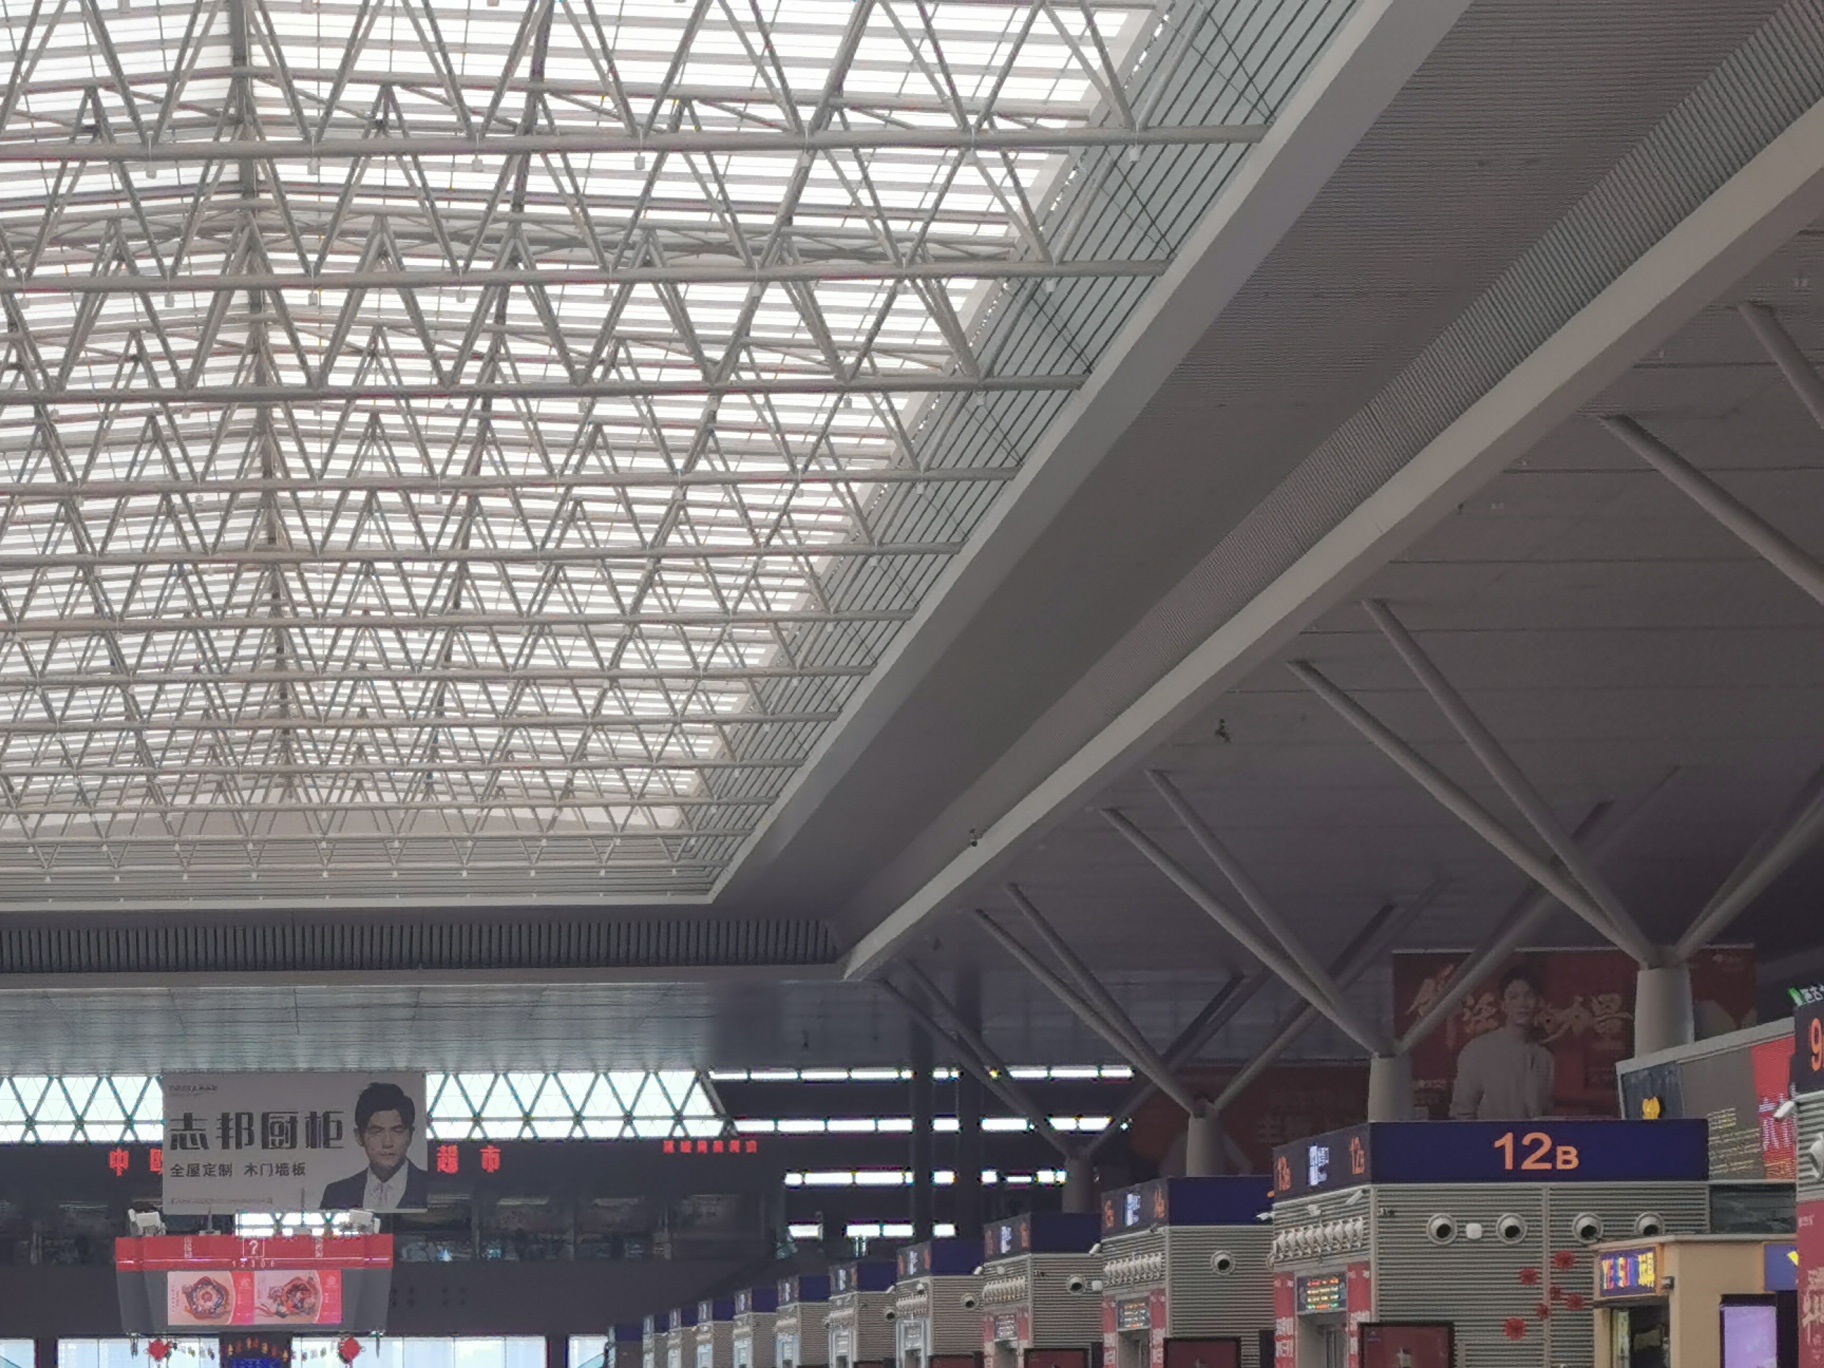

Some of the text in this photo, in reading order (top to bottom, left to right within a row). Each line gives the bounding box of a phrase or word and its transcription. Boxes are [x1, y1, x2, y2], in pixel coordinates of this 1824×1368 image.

[1810, 1018, 1824, 1071] 9
[170, 1111, 344, 1150] 志邦厨柜
[170, 1162, 306, 1178] 全屋定制 木门墙板
[437, 1145, 501, 1174] 超市
[1494, 1132, 1579, 1171] 12B
